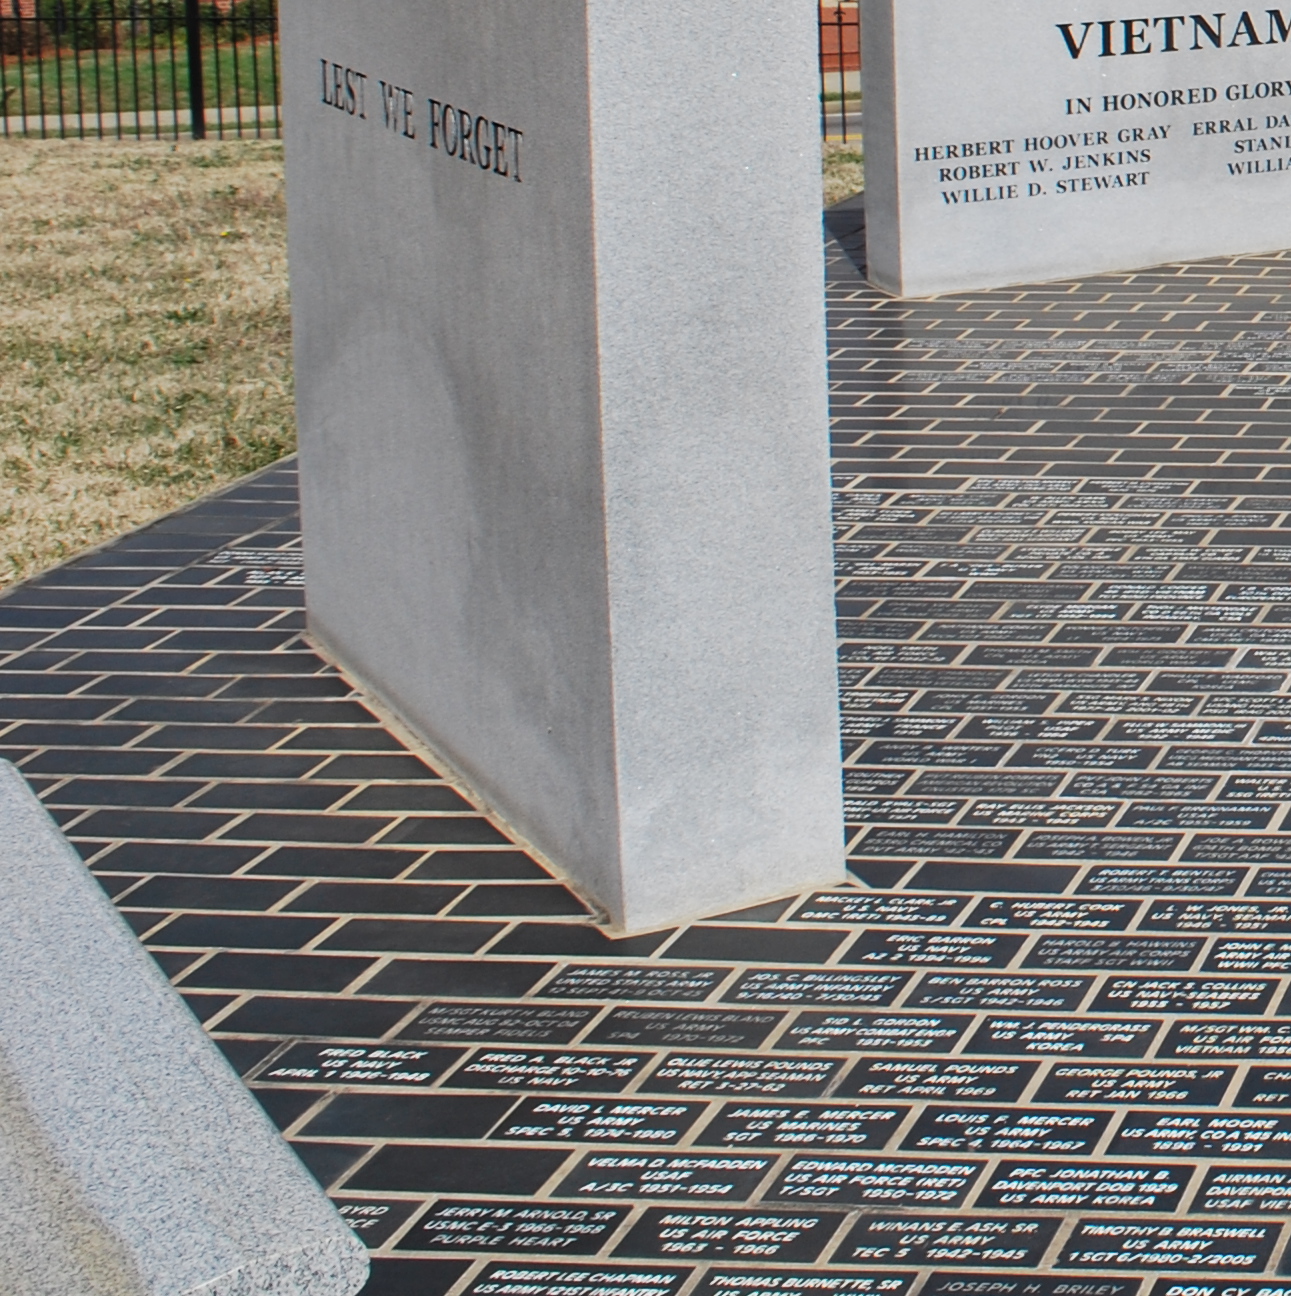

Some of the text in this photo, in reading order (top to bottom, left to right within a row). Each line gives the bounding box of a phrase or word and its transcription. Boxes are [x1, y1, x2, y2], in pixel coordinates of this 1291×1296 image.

[1066, 97, 1091, 115] IN
[1103, 87, 1217, 112] HONORED
[320, 58, 523, 182] LEST WE FORGET
[1193, 117, 1258, 136] ERRAL
[915, 125, 1171, 162] HERBERT HOOVER GRAY
[939, 149, 1151, 182] ROBERT W. JENKINS
[941, 171, 1150, 204] WILLIE D. STEWART
[658, 1215, 819, 1229] MILTON APPLING
[658, 1228, 801, 1242] US AIR FORCE
[660, 1242, 708, 1252] 1963
[733, 1244, 781, 1255] 1966
